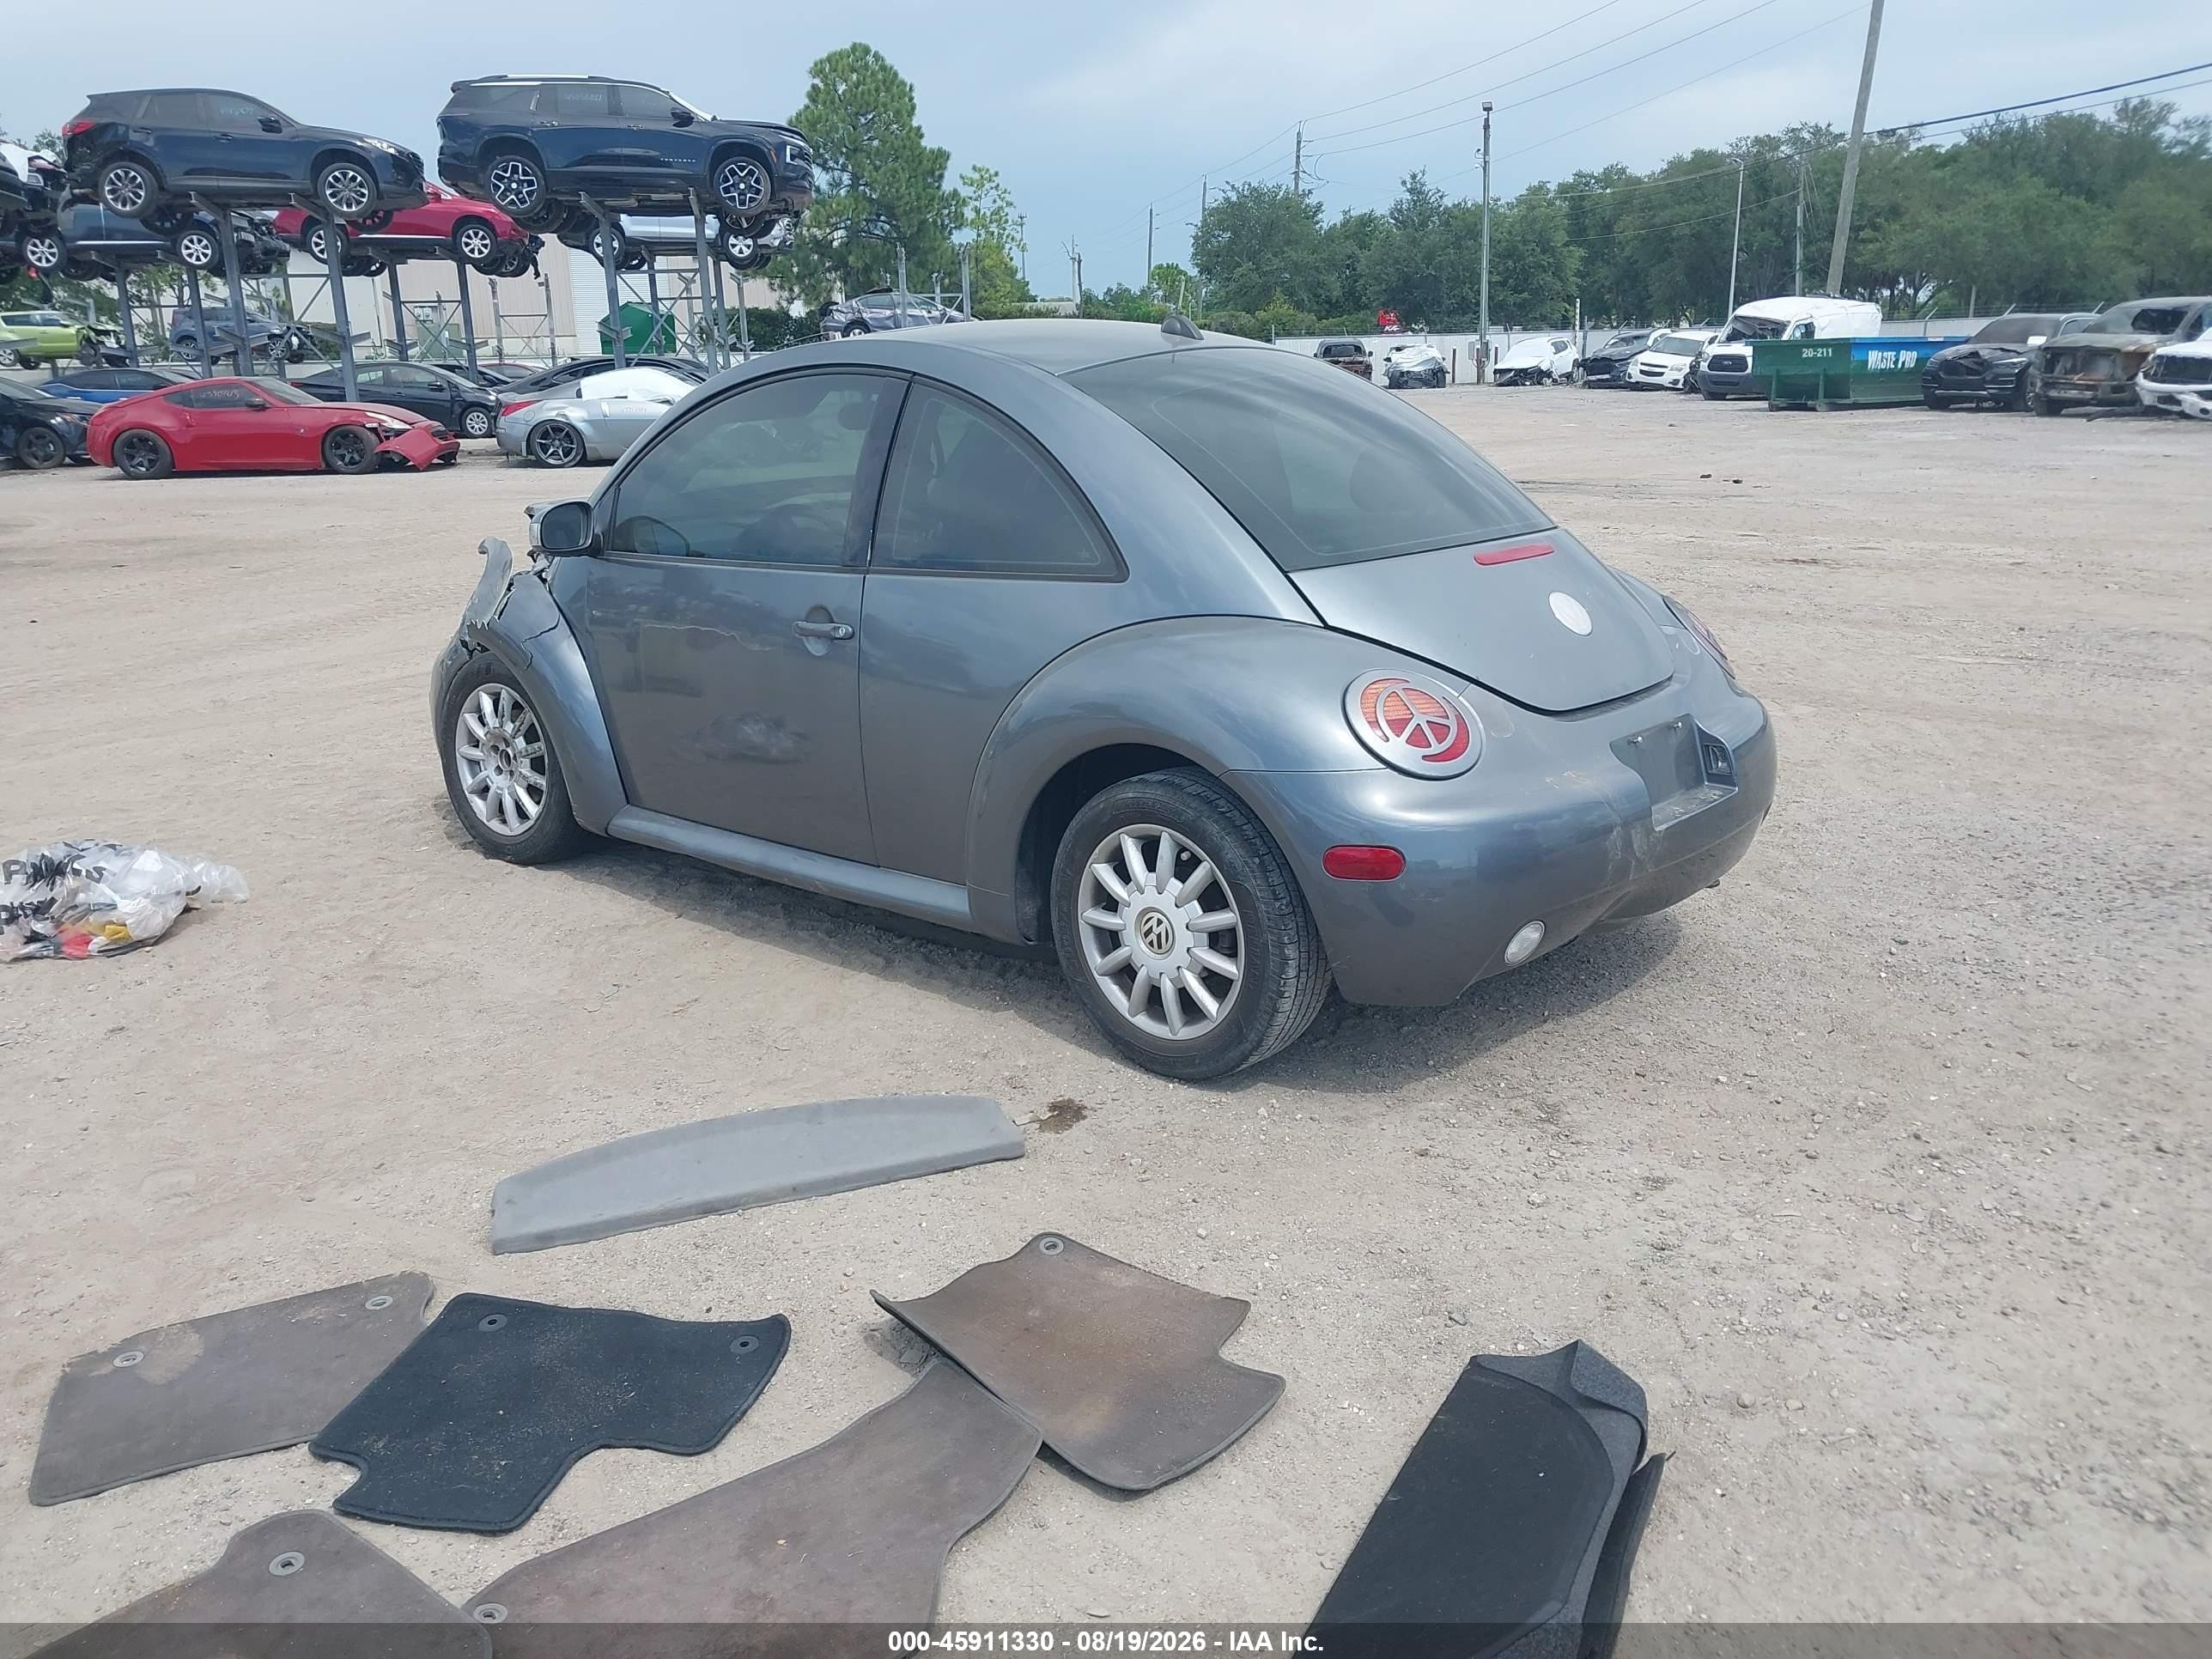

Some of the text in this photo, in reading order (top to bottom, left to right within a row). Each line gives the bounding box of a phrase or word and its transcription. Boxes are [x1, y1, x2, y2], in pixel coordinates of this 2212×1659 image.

[1802, 348, 1832, 357] 20-211
[1868, 349, 1917, 371] WASTE PRO
